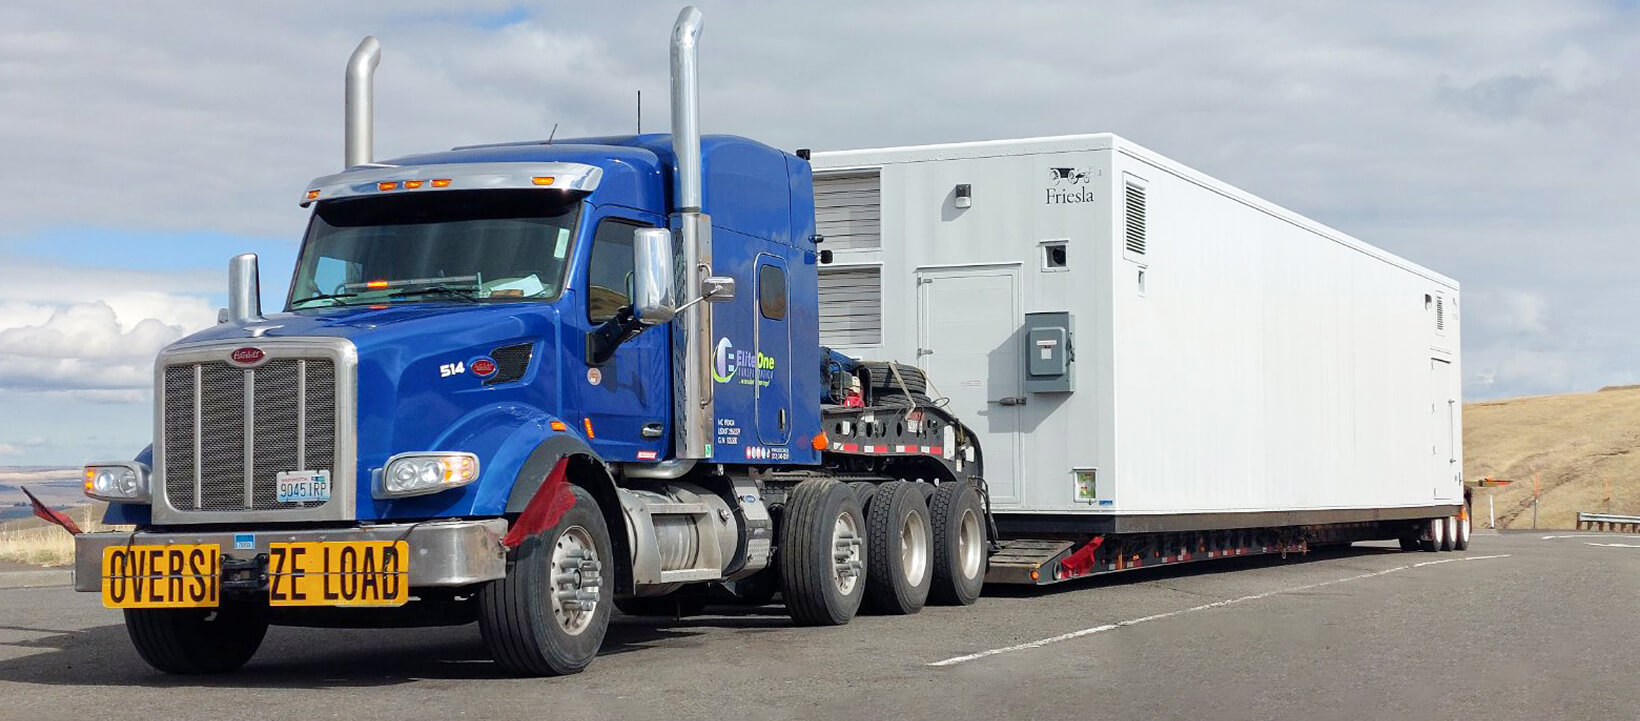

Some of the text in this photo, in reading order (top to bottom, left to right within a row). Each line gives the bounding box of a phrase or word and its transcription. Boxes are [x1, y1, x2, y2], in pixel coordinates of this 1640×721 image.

[1045, 186, 1094, 204] Friesla
[440, 361, 465, 378] 514
[324, 546, 399, 601] LOAD
